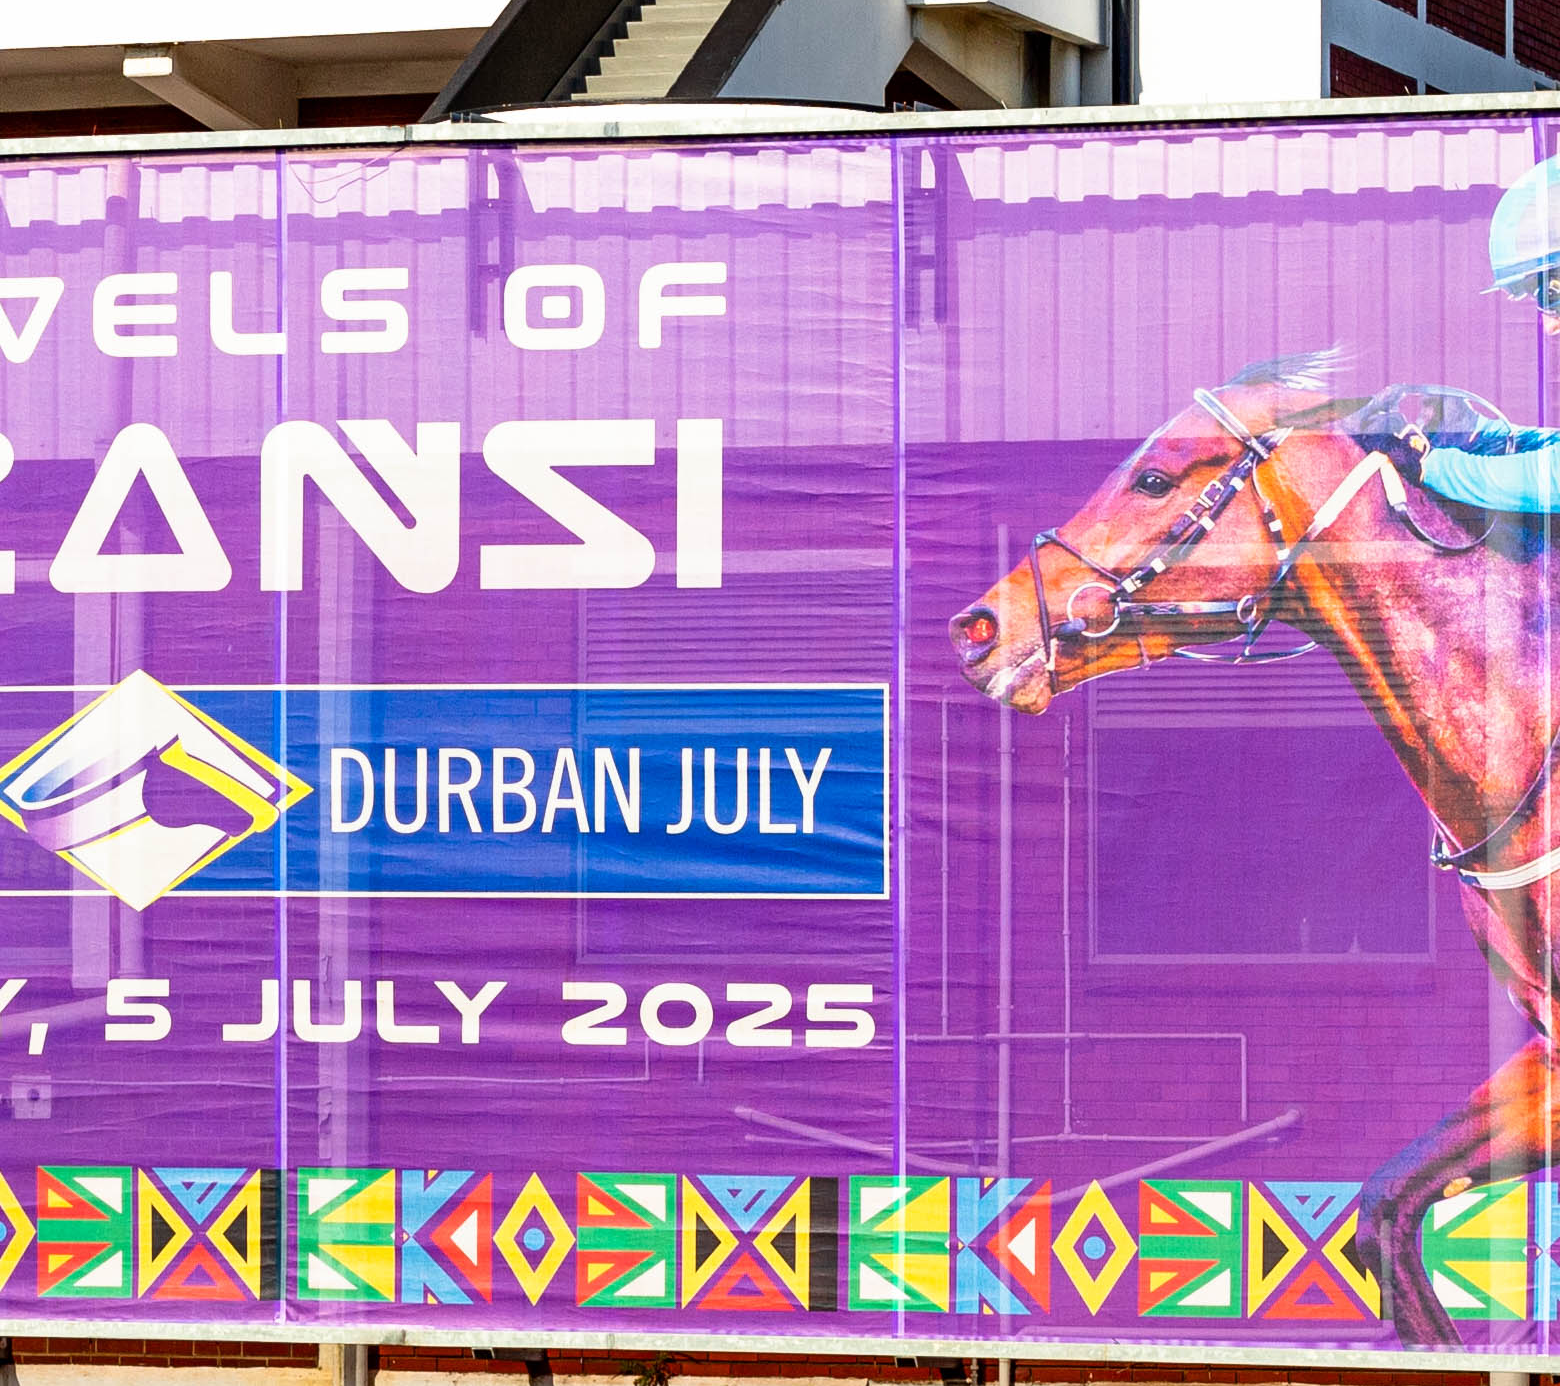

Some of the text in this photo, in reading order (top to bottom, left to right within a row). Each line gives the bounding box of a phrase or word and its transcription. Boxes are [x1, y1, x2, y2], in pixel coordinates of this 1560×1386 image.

[503, 262, 728, 351] OF
[330, 747, 832, 834] DURBAN JULY
[105, 978, 172, 1041] 5
[222, 979, 507, 1045] JULY
[561, 982, 876, 1048] 2025
